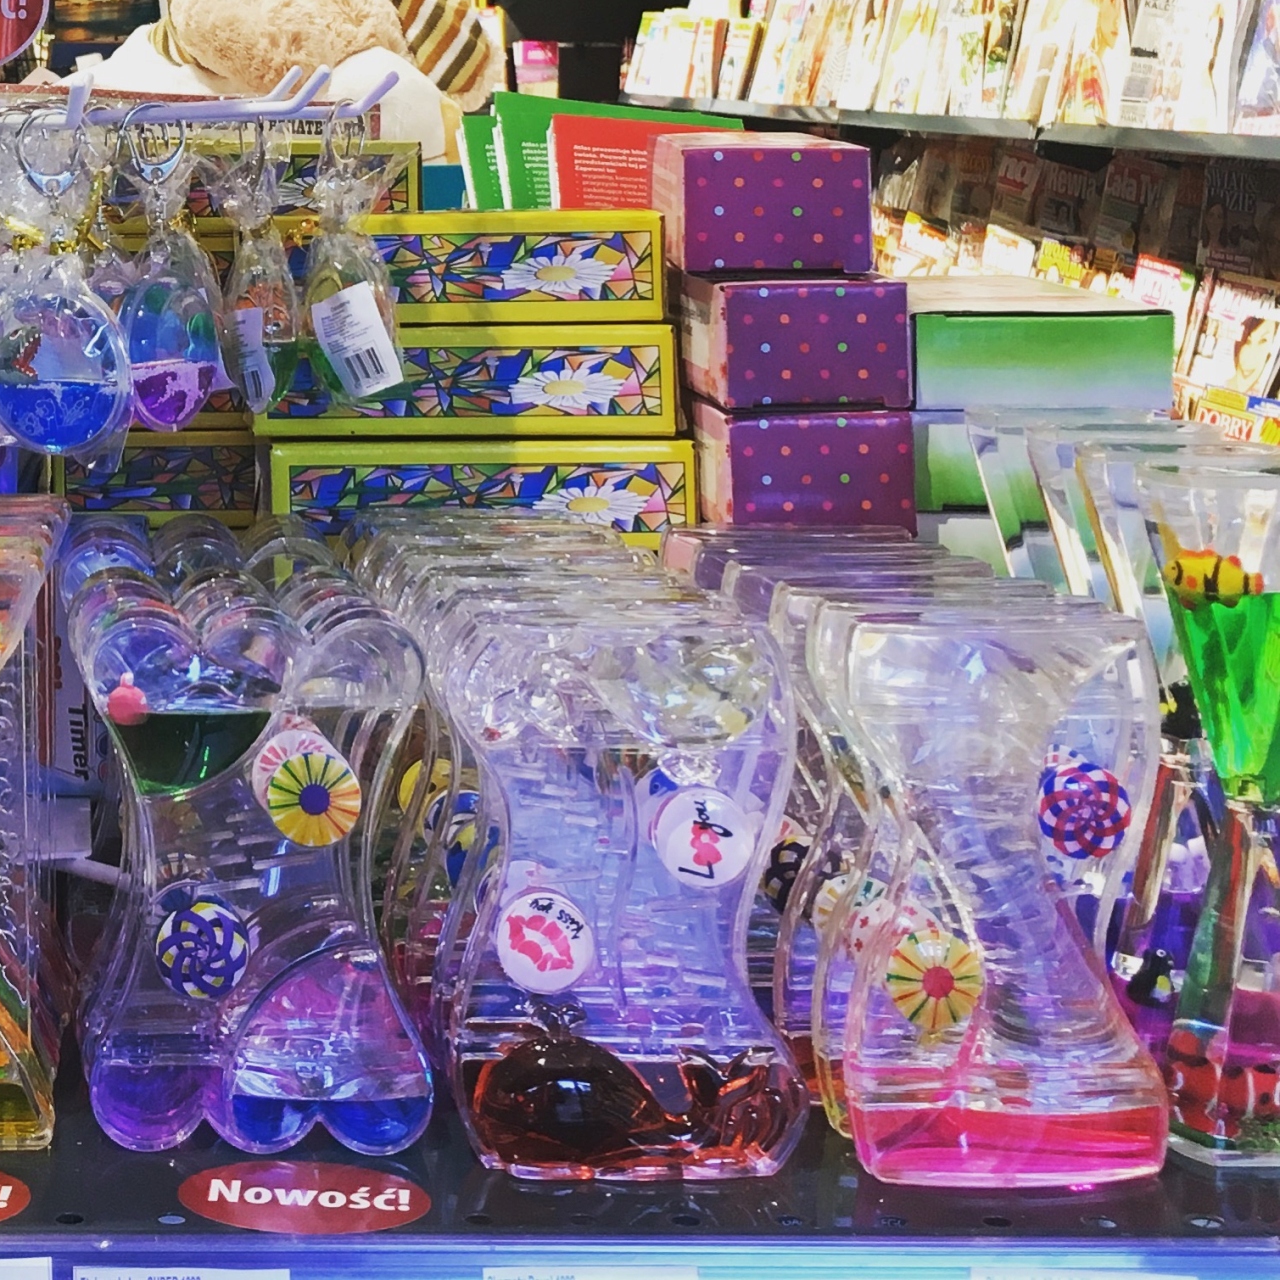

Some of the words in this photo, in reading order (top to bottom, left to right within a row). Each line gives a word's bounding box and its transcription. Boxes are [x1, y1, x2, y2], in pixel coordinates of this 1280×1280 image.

[1197, 406, 1254, 443] DOBRY
[68, 703, 89, 782] Timer
[207, 1178, 411, 1212] Nowość!
